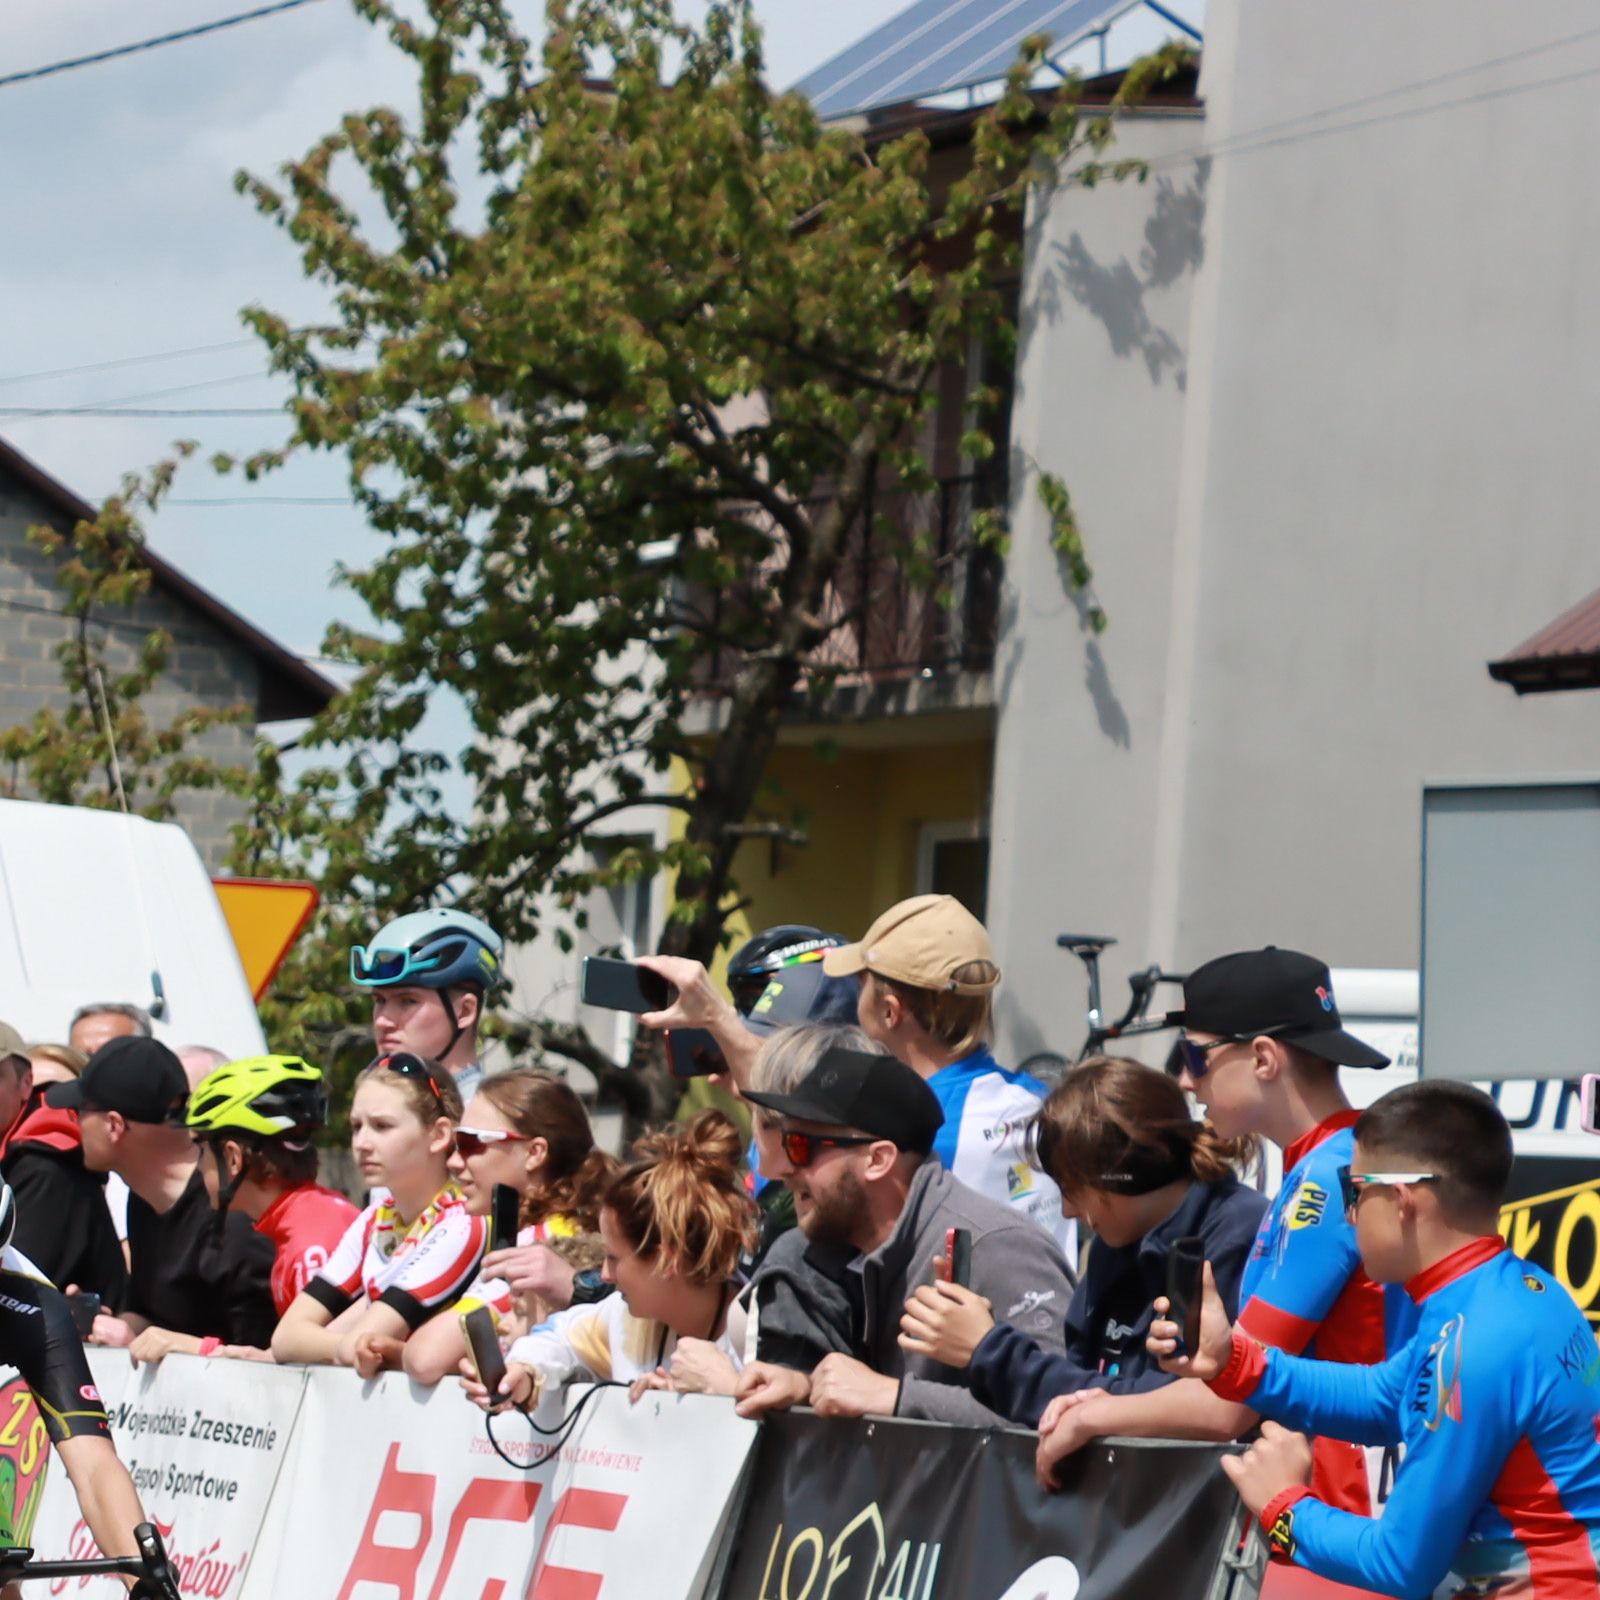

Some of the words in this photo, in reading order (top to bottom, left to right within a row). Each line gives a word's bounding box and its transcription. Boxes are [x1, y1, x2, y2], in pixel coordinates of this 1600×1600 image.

[1295, 1188, 1330, 1226] PKS
[189, 1410, 278, 1452] Zrzeszenie
[165, 1463, 238, 1502] Sportowe
